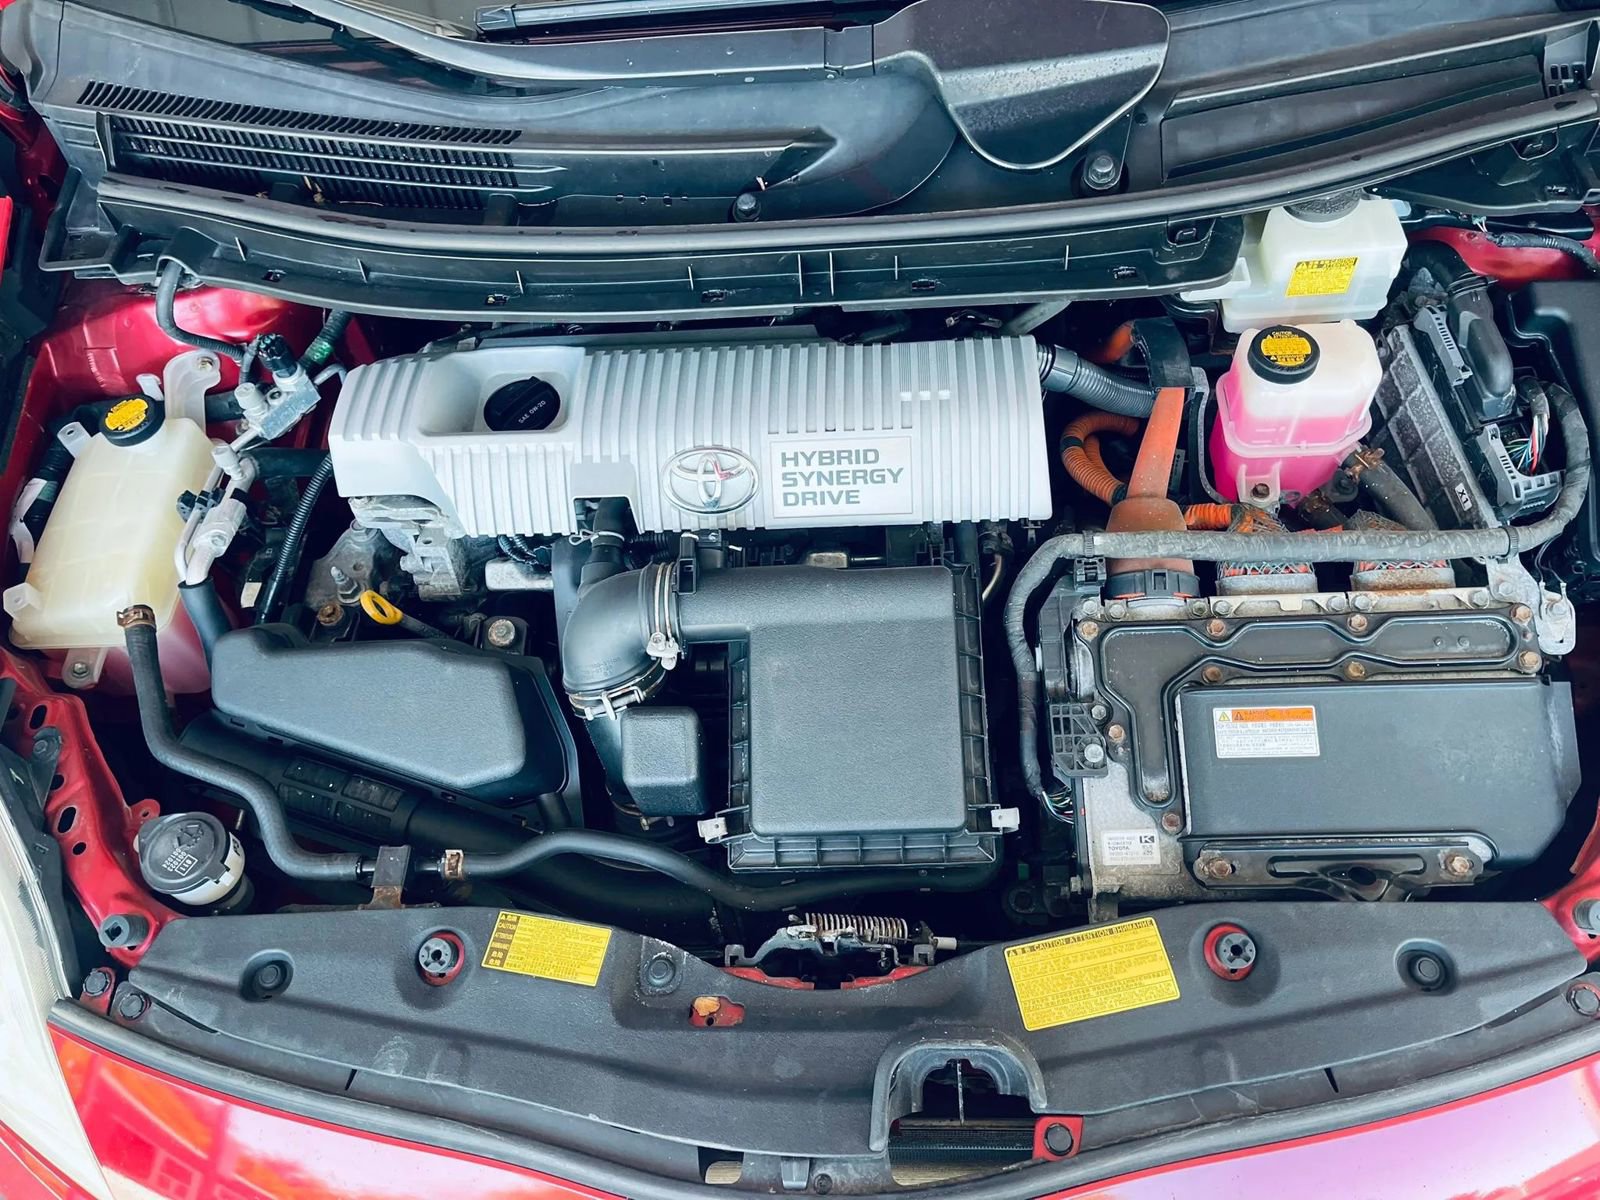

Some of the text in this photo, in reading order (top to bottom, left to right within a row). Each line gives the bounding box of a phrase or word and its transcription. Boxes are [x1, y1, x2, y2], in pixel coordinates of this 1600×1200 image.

[518, 400, 547, 424] SAE 0W-20
[781, 448, 880, 467] HYBRID
[781, 467, 904, 487] SYNERGY
[783, 489, 861, 507] DRIVE
[1458, 489, 1468, 503] X1
[1034, 937, 1067, 951] CAUTION
[1070, 928, 1111, 944] ATTENTION
